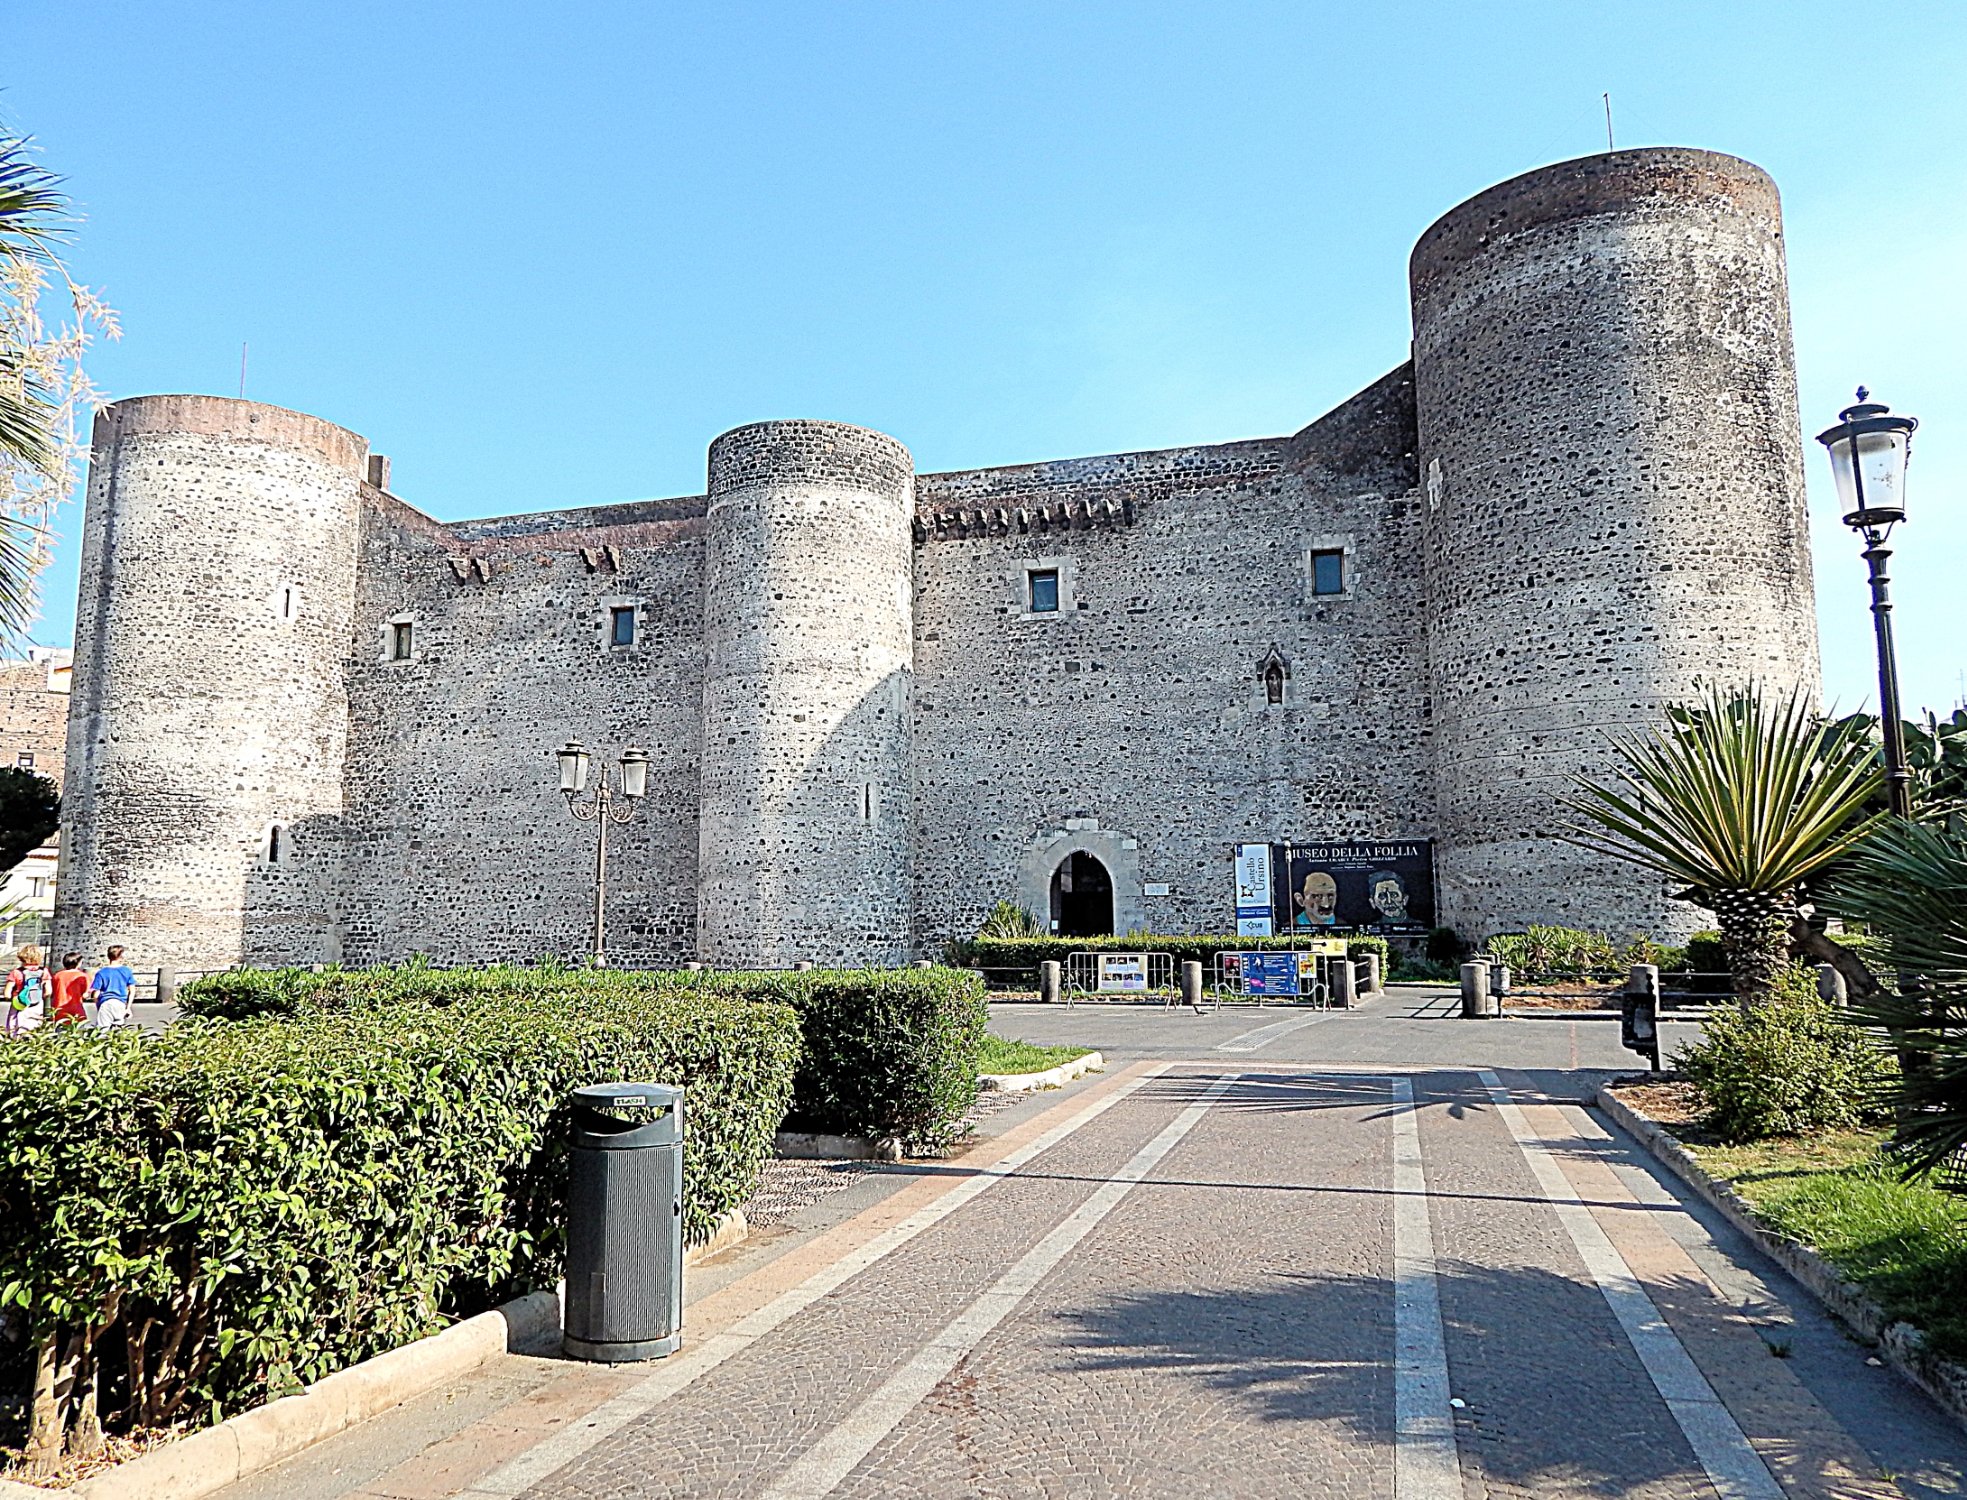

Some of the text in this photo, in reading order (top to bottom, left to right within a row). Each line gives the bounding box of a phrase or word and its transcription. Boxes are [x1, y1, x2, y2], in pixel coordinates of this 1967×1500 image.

[1331, 847, 1371, 857] DELLA
[1374, 846, 1418, 856] FOLLIA
[1246, 857, 1256, 891] Castello
[1255, 857, 1265, 891] Ursino
